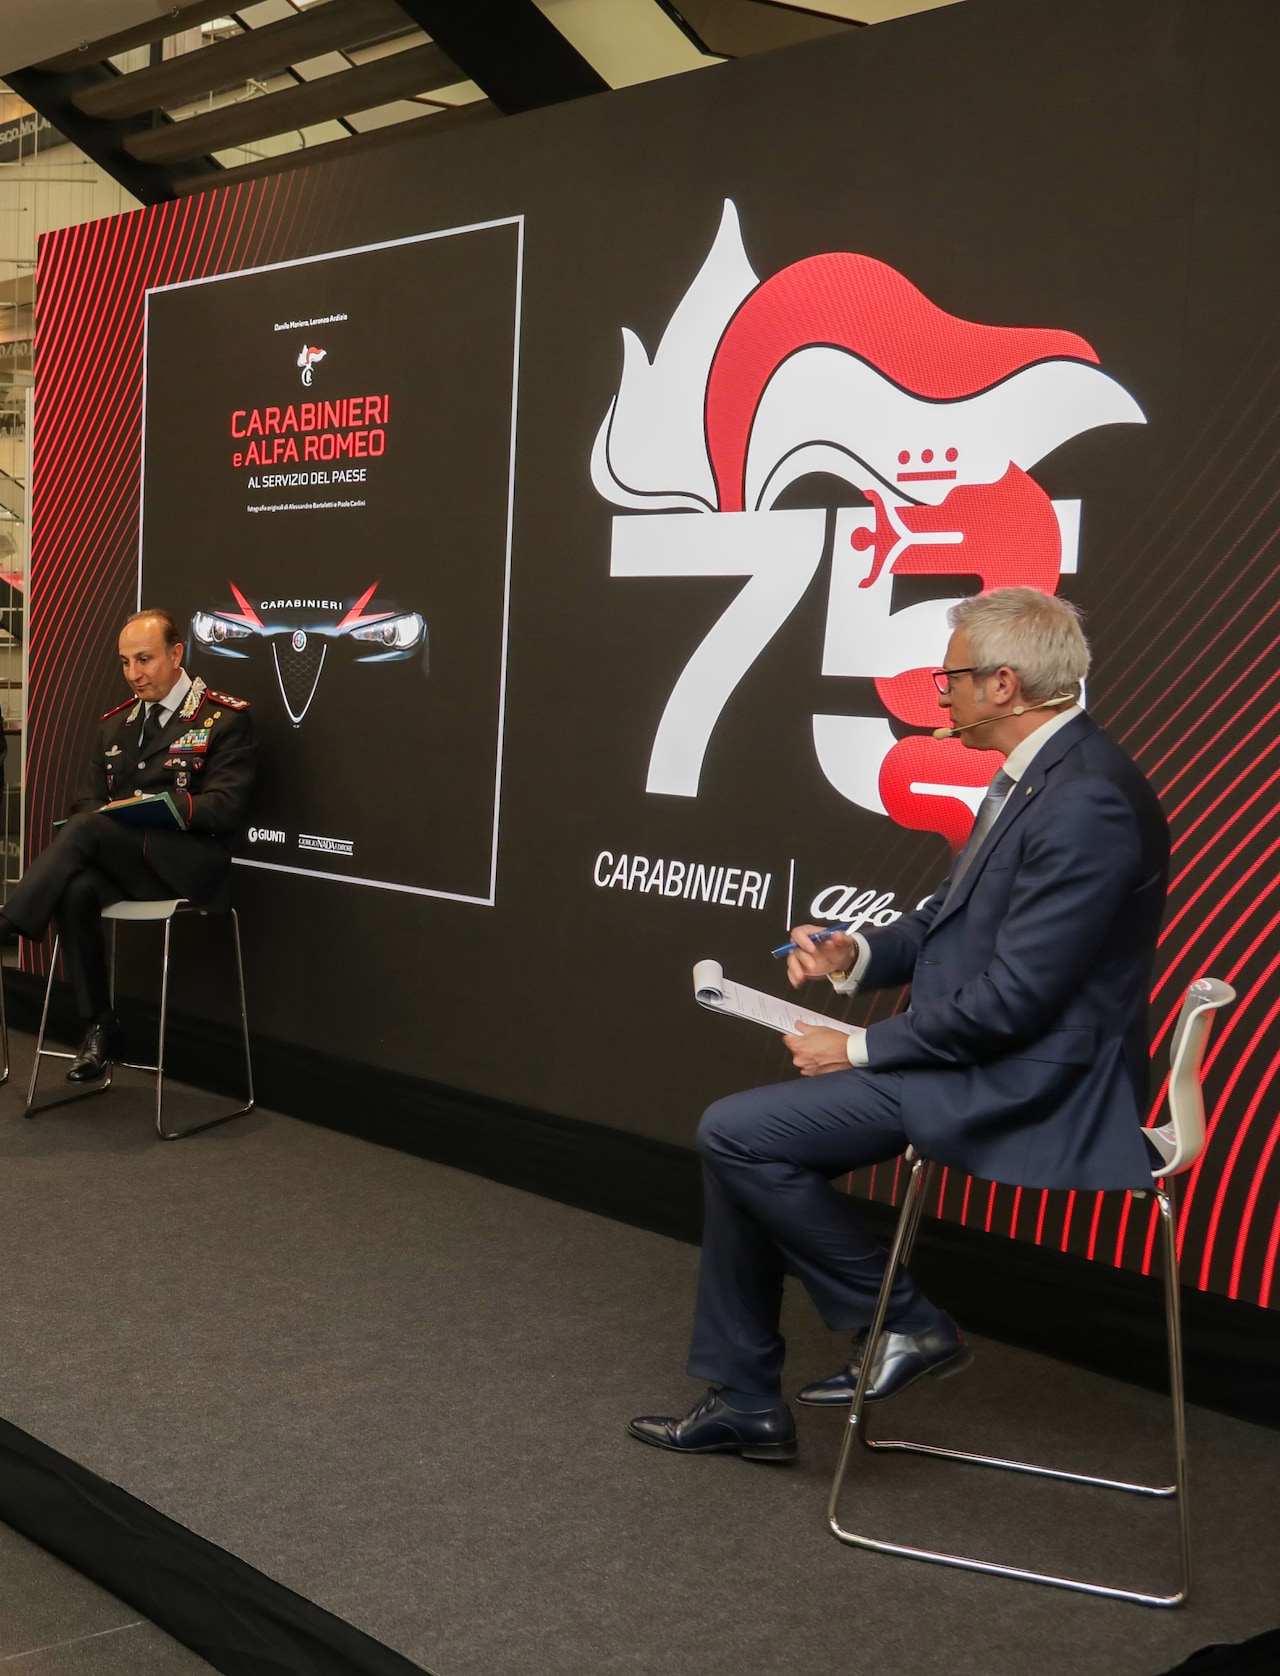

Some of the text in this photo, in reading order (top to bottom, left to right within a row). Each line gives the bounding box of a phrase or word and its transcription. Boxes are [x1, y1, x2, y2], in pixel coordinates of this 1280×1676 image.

[231, 394, 389, 438] CARABINIERI
[233, 429, 385, 467] e ALFA ROMEO
[248, 469, 367, 489] AL SERVIZIO DEL PAESE
[260, 599, 343, 611] CARABINIERI
[258, 828, 285, 843] GIUNTI
[593, 850, 772, 910] CARABINIERI
